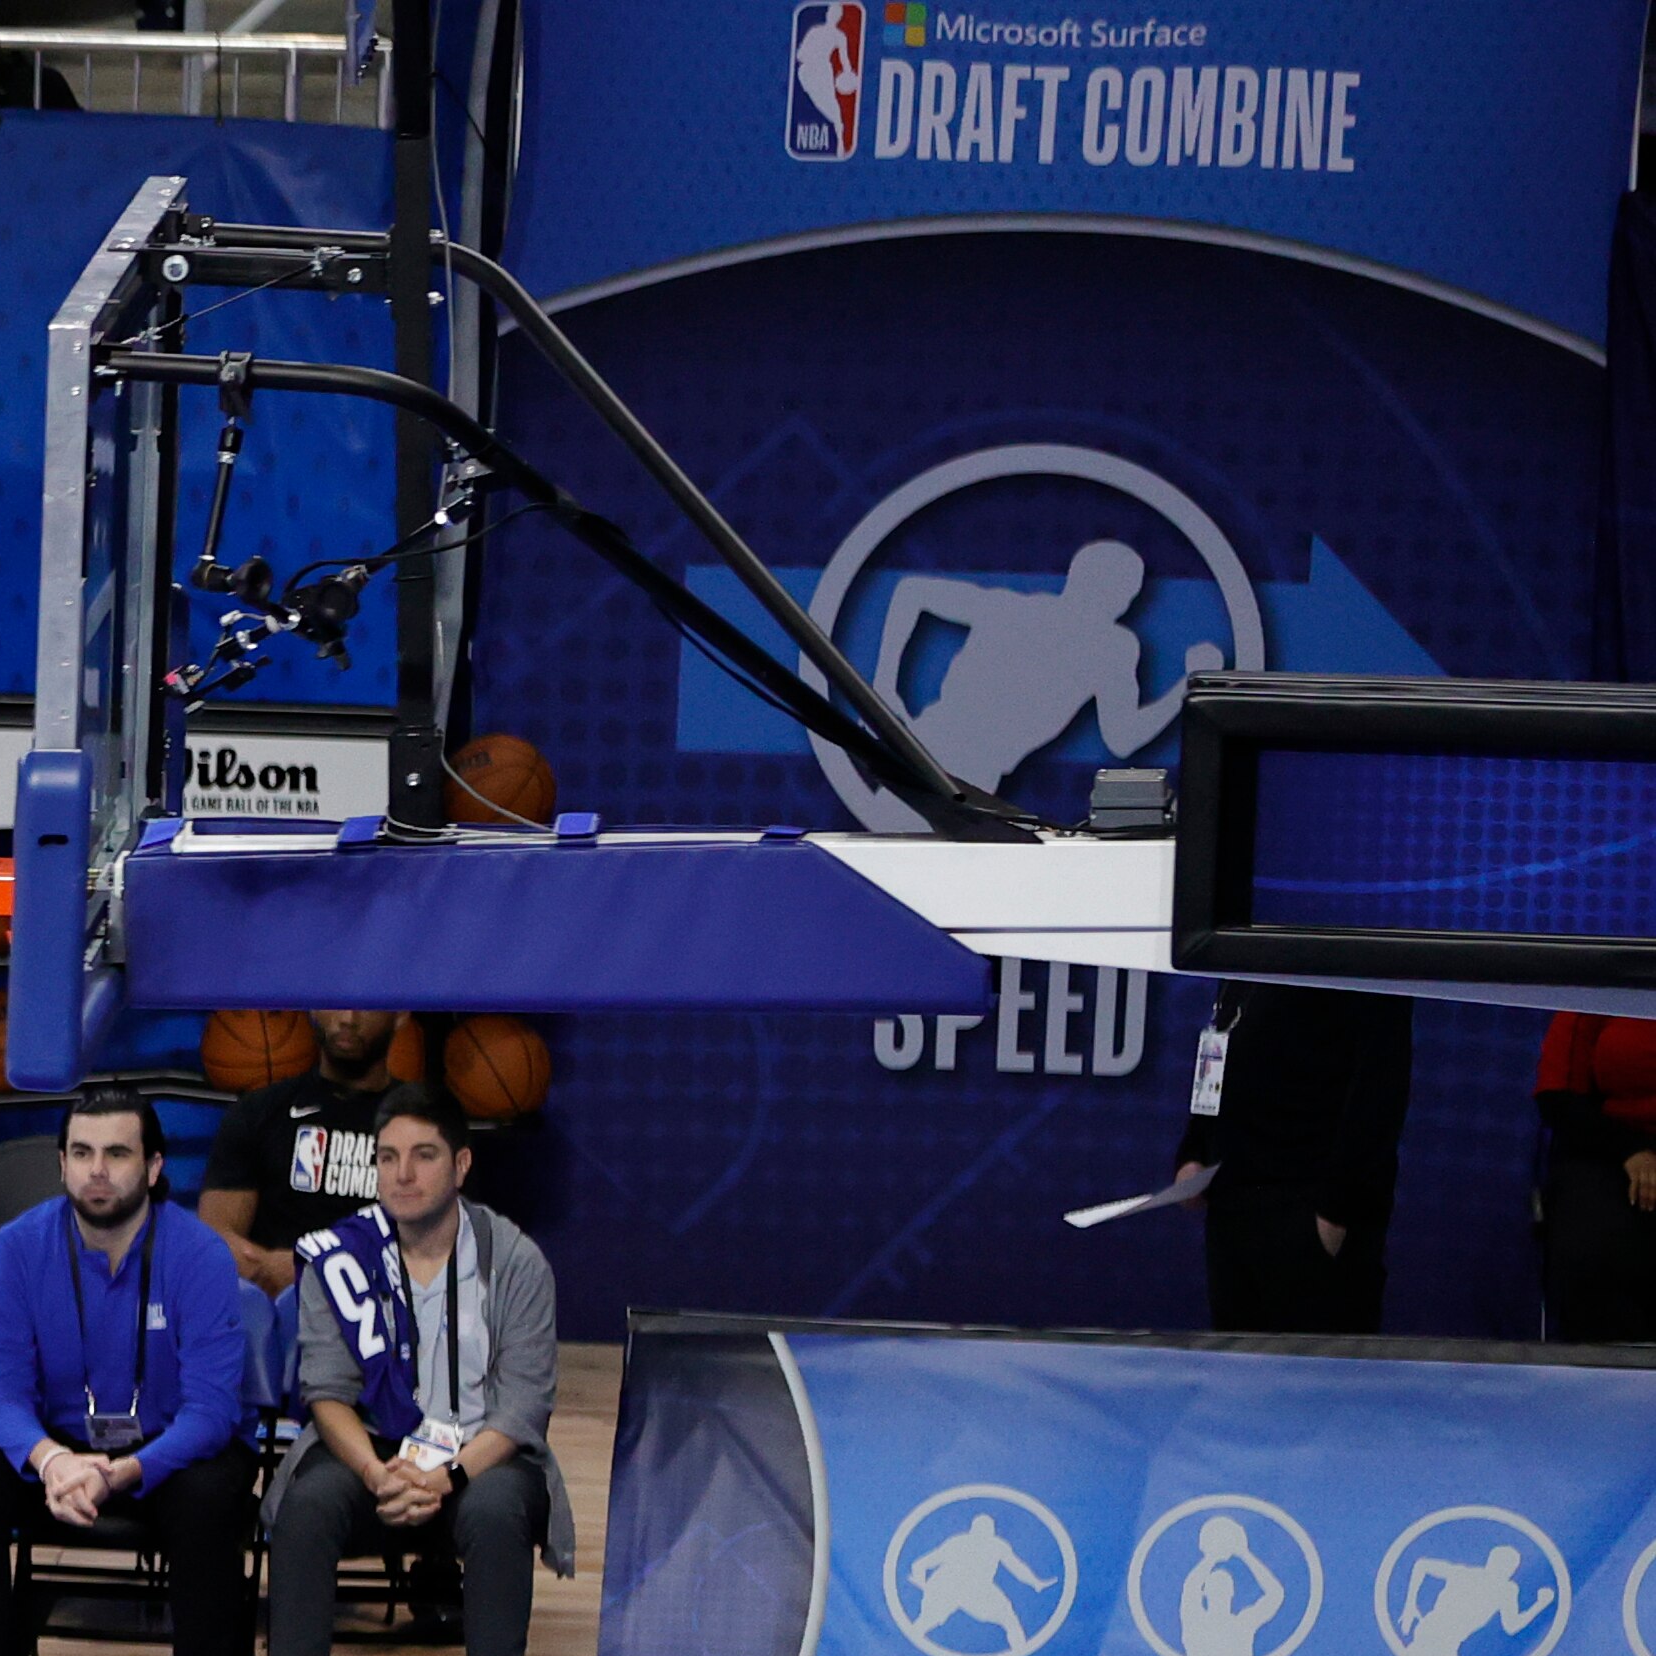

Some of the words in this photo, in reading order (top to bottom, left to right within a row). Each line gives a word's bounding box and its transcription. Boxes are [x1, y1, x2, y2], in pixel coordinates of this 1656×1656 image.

[936, 12, 1081, 47] Microsoft
[1091, 19, 1207, 48] Surface
[874, 58, 1070, 165] DRAFT
[1081, 65, 1360, 172] COMBINE
[796, 124, 830, 151] NBA
[184, 748, 319, 792] ilson
[192, 793, 221, 812] GAME
[226, 795, 252, 813] BALL
[256, 797, 270, 814] OF
[273, 797, 293, 814] THE
[297, 799, 320, 815] NBA
[328, 1129, 376, 1165] DRAF
[324, 1163, 380, 1199] COMB
